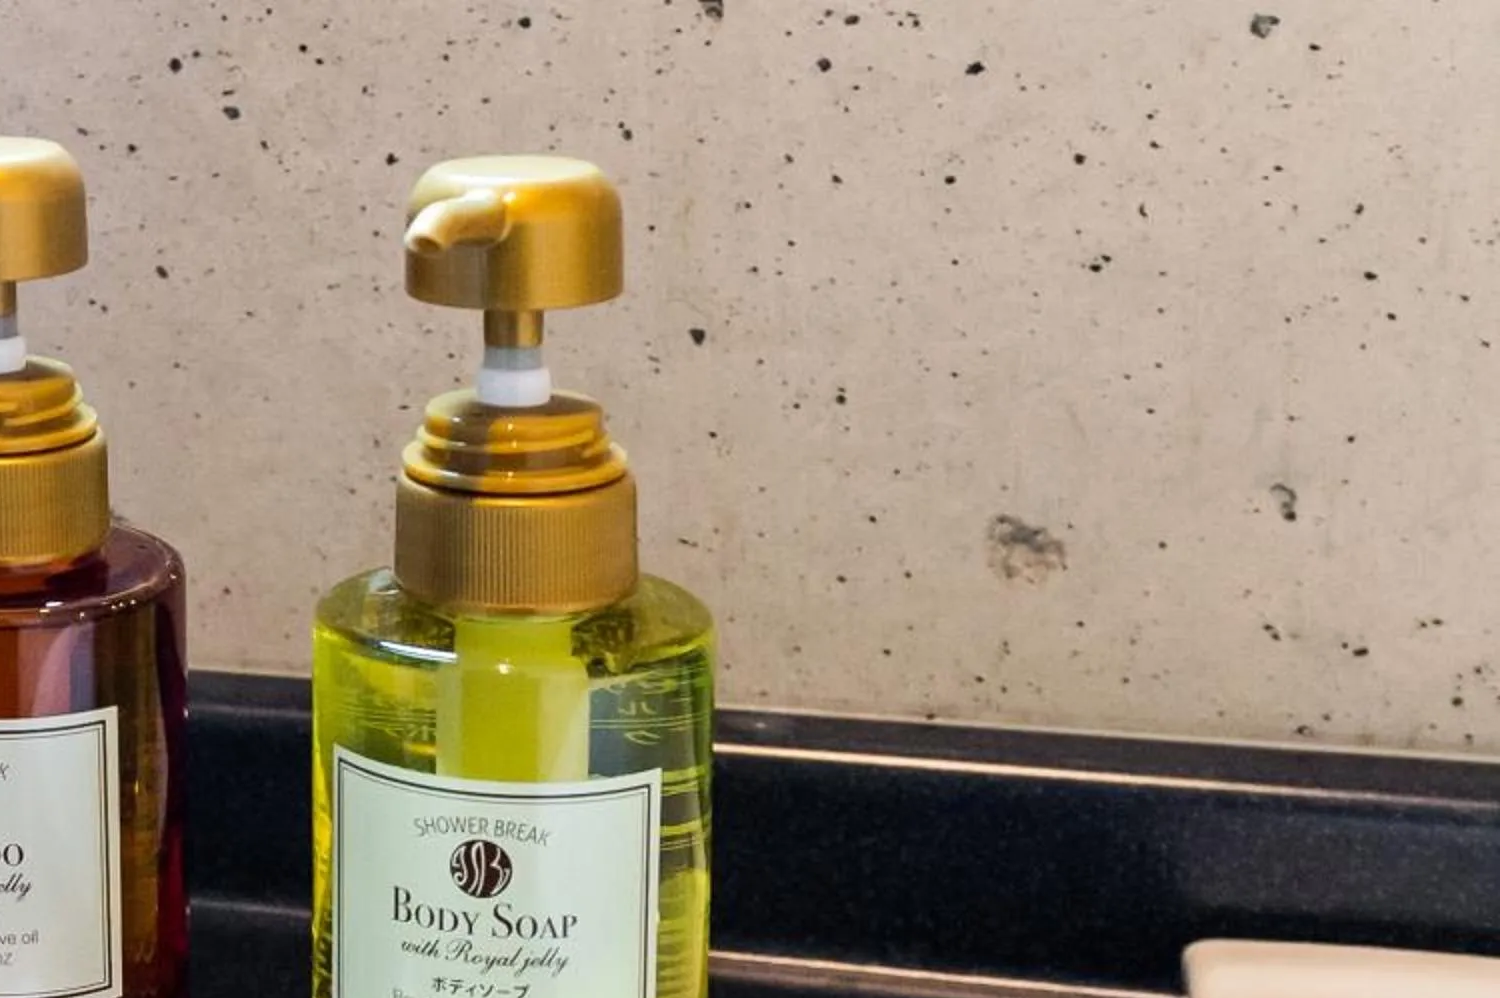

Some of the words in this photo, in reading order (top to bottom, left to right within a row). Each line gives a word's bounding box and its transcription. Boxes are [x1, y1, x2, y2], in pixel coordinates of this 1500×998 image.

[413, 815, 489, 838] SHOWER
[494, 818, 553, 847] BREAK
[391, 885, 481, 934] BODY
[491, 902, 579, 940] SOAP
[21, 929, 39, 944] oil
[400, 939, 441, 958] with
[445, 939, 520, 976] Royal
[514, 947, 570, 978] jelly
